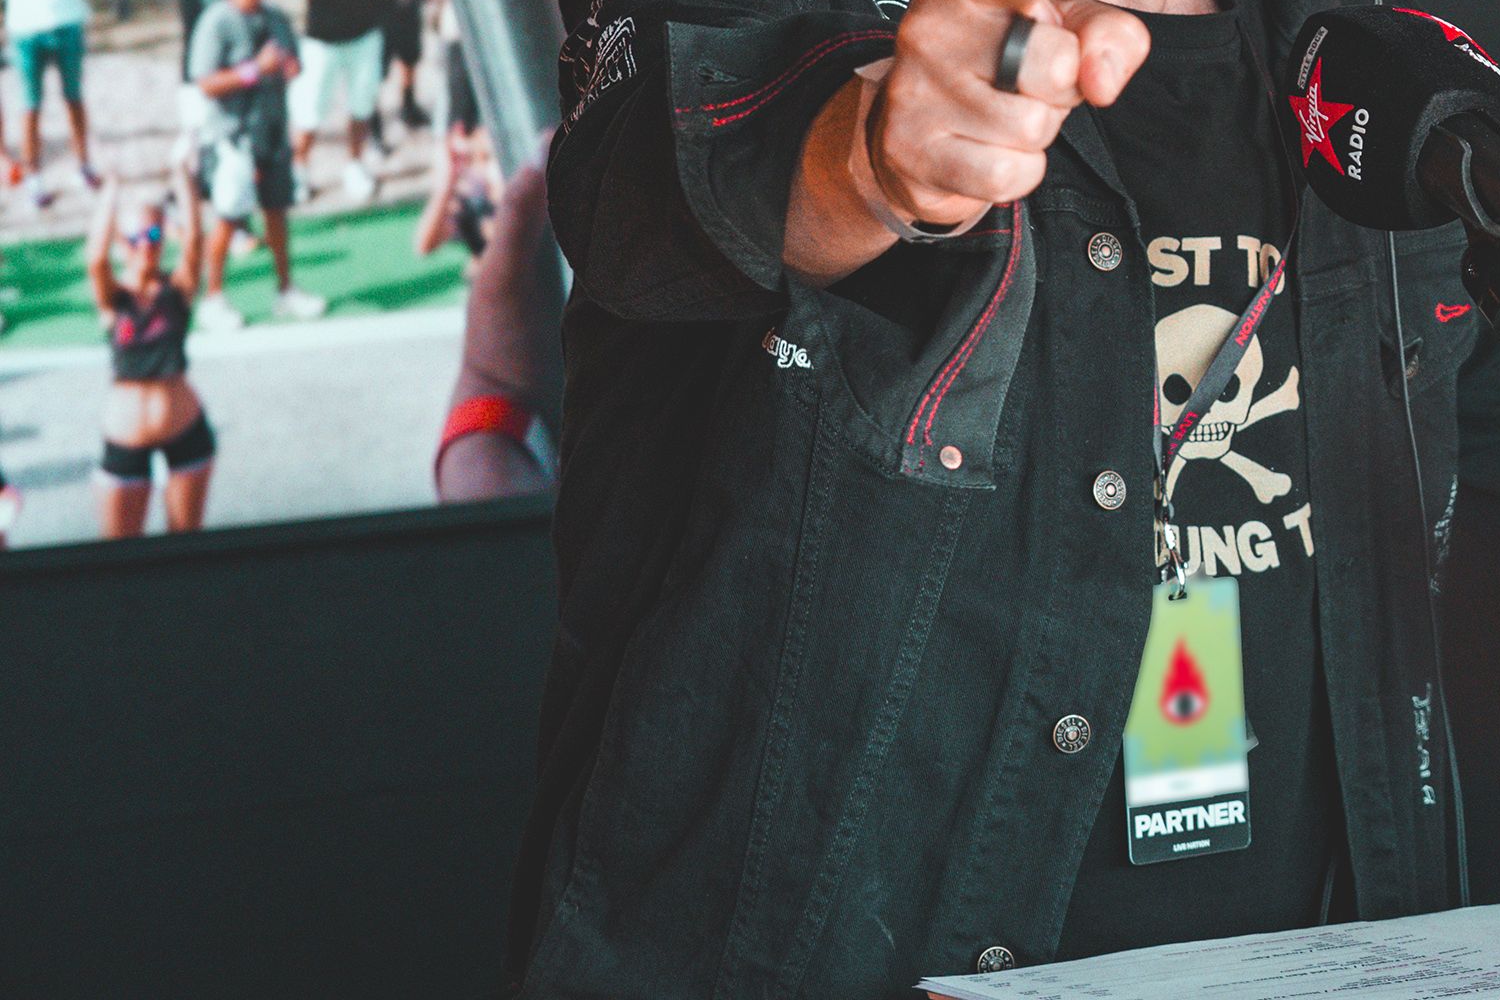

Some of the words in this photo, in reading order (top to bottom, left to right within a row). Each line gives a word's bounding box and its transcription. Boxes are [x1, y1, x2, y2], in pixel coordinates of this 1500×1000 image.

[1298, 56, 1313, 89] STYLE
[1308, 28, 1327, 56] ROCK
[1299, 83, 1329, 144] Virgin
[1348, 108, 1370, 180] RADIO
[1147, 236, 1222, 288] ST
[1235, 289, 1272, 347] NATION
[1173, 411, 1199, 441] LIVE
[1134, 800, 1246, 839] PARTNER
